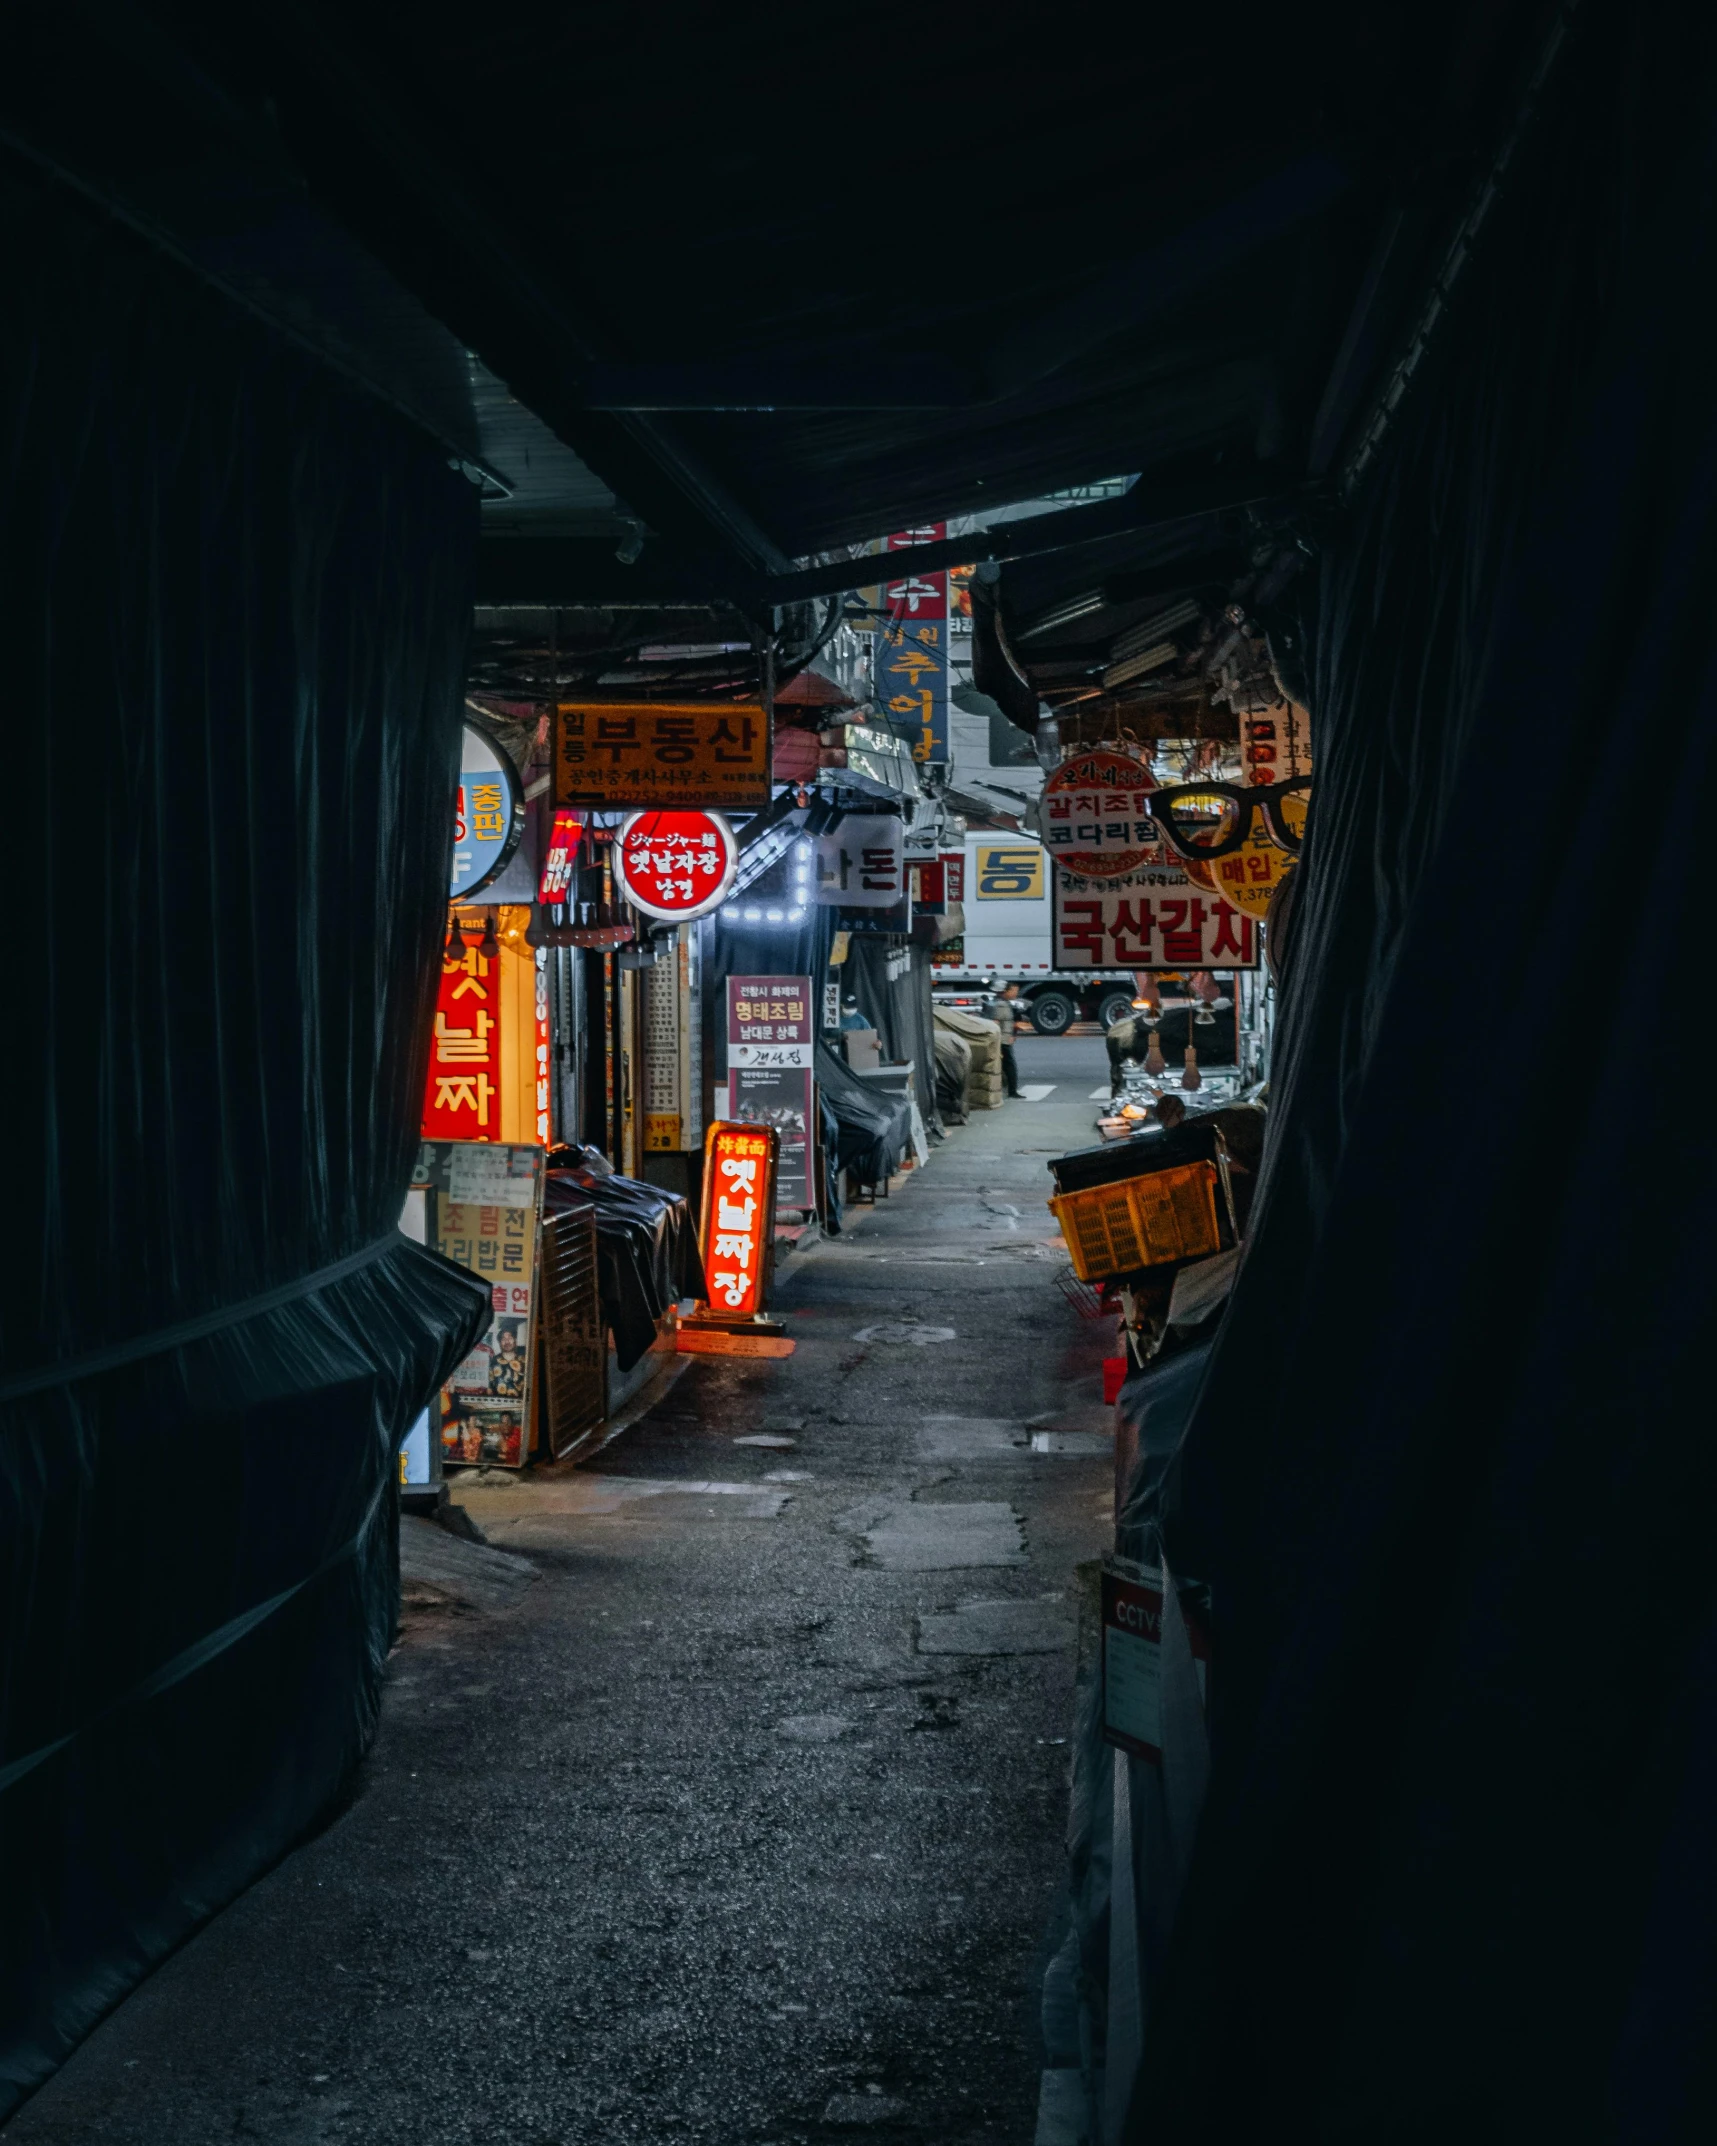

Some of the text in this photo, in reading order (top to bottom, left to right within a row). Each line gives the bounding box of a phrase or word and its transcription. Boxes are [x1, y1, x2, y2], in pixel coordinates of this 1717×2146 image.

[562, 713, 587, 763] 일등
[591, 717, 758, 764] 부동산
[568, 768, 712, 785] 공인중개사사무소
[1049, 822, 1159, 845] 코다리찜
[630, 850, 721, 875] 옛날자장
[981, 851, 1040, 893] 동
[1060, 900, 1250, 965] 국산갈치
[735, 1002, 804, 1022] 명태조림
[434, 948, 494, 1141] 옛날짜
[740, 1026, 798, 1041] 남대문 상륙
[714, 1159, 757, 1307] 옛날짜장
[1116, 1600, 1155, 1632] CCTV
